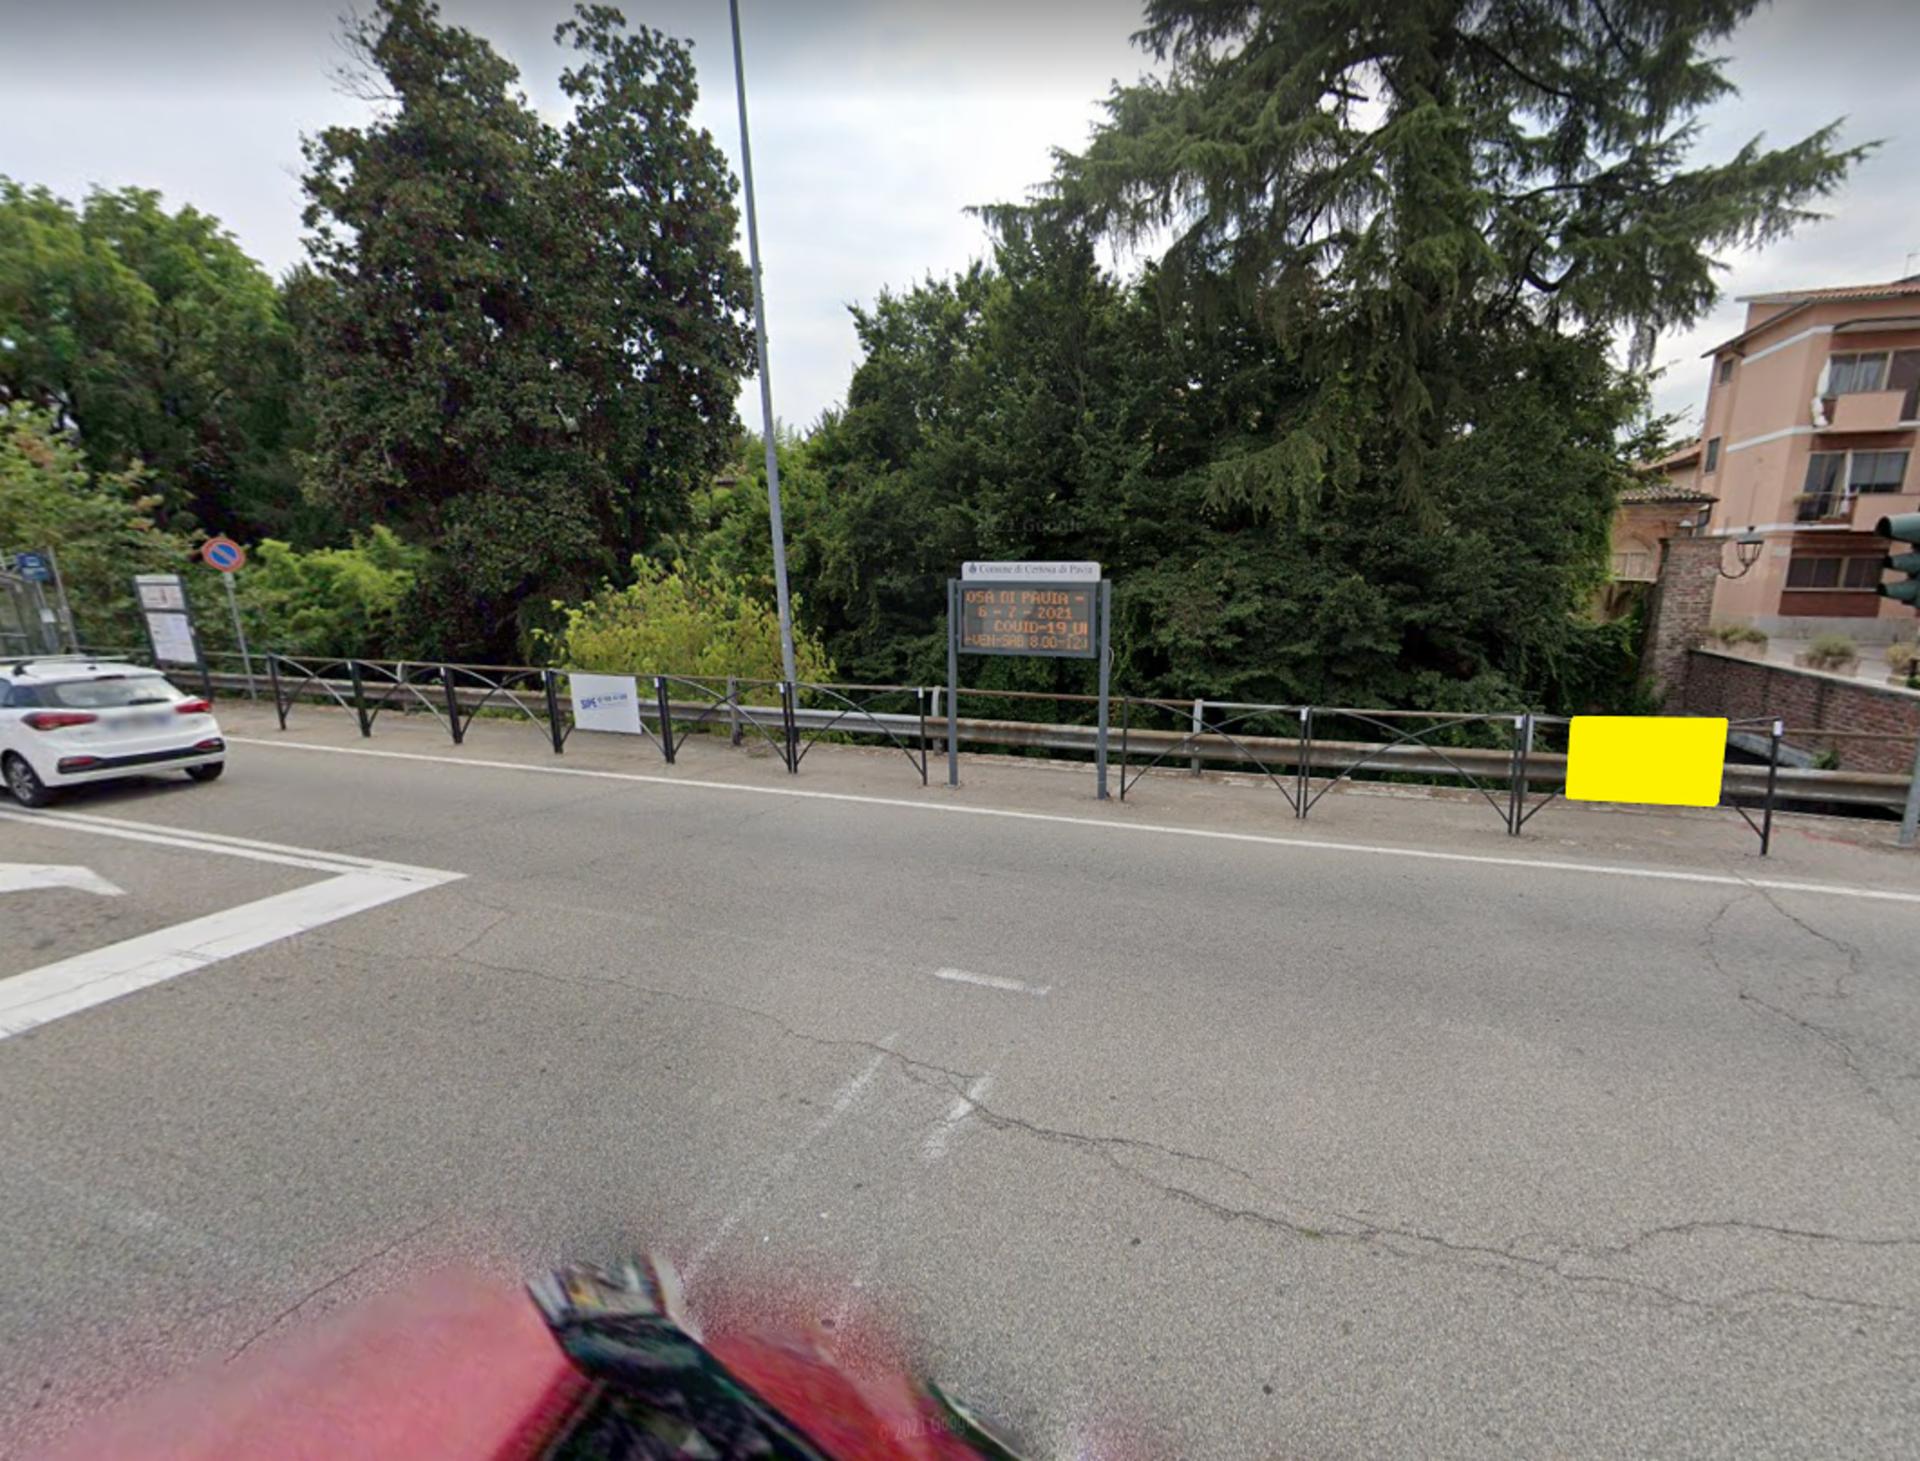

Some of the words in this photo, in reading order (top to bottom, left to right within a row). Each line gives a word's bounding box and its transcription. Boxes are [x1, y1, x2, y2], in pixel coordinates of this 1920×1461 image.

[979, 565, 1012, 574] Comune
[1024, 565, 1057, 574] Certosa
[1059, 565, 1067, 574] di
[1070, 565, 1093, 575] Pavia
[1021, 591, 1069, 606] PAVIA
[1037, 607, 1073, 620] 2021
[993, 620, 1067, 635] COVID-19
